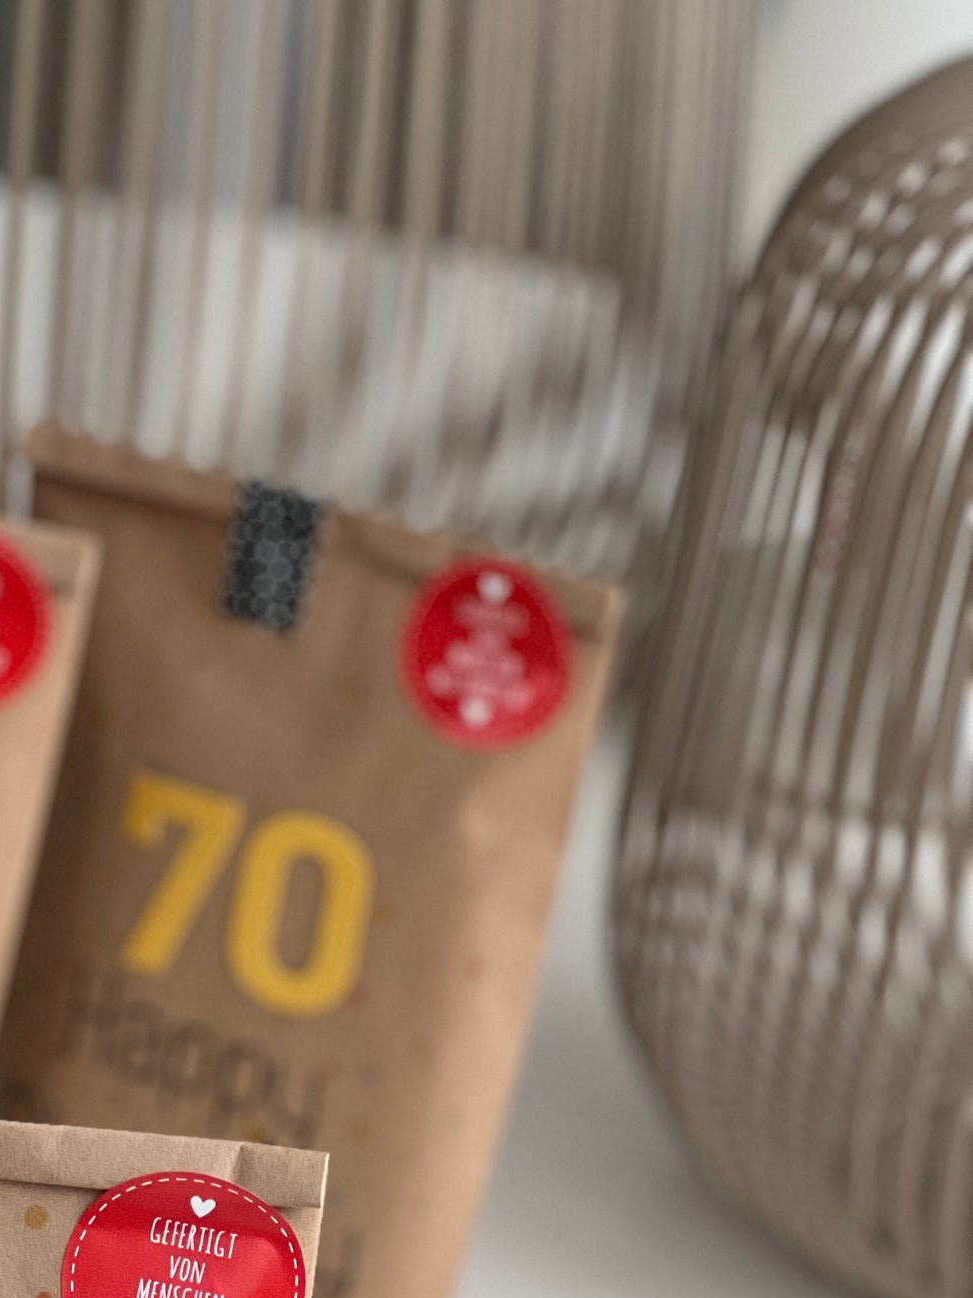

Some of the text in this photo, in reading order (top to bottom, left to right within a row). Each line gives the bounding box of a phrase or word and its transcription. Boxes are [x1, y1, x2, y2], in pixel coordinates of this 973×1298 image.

[125, 769, 375, 1017] 70
[150, 1216, 238, 1258] GEFERTIGT
[170, 1255, 205, 1284] VON
